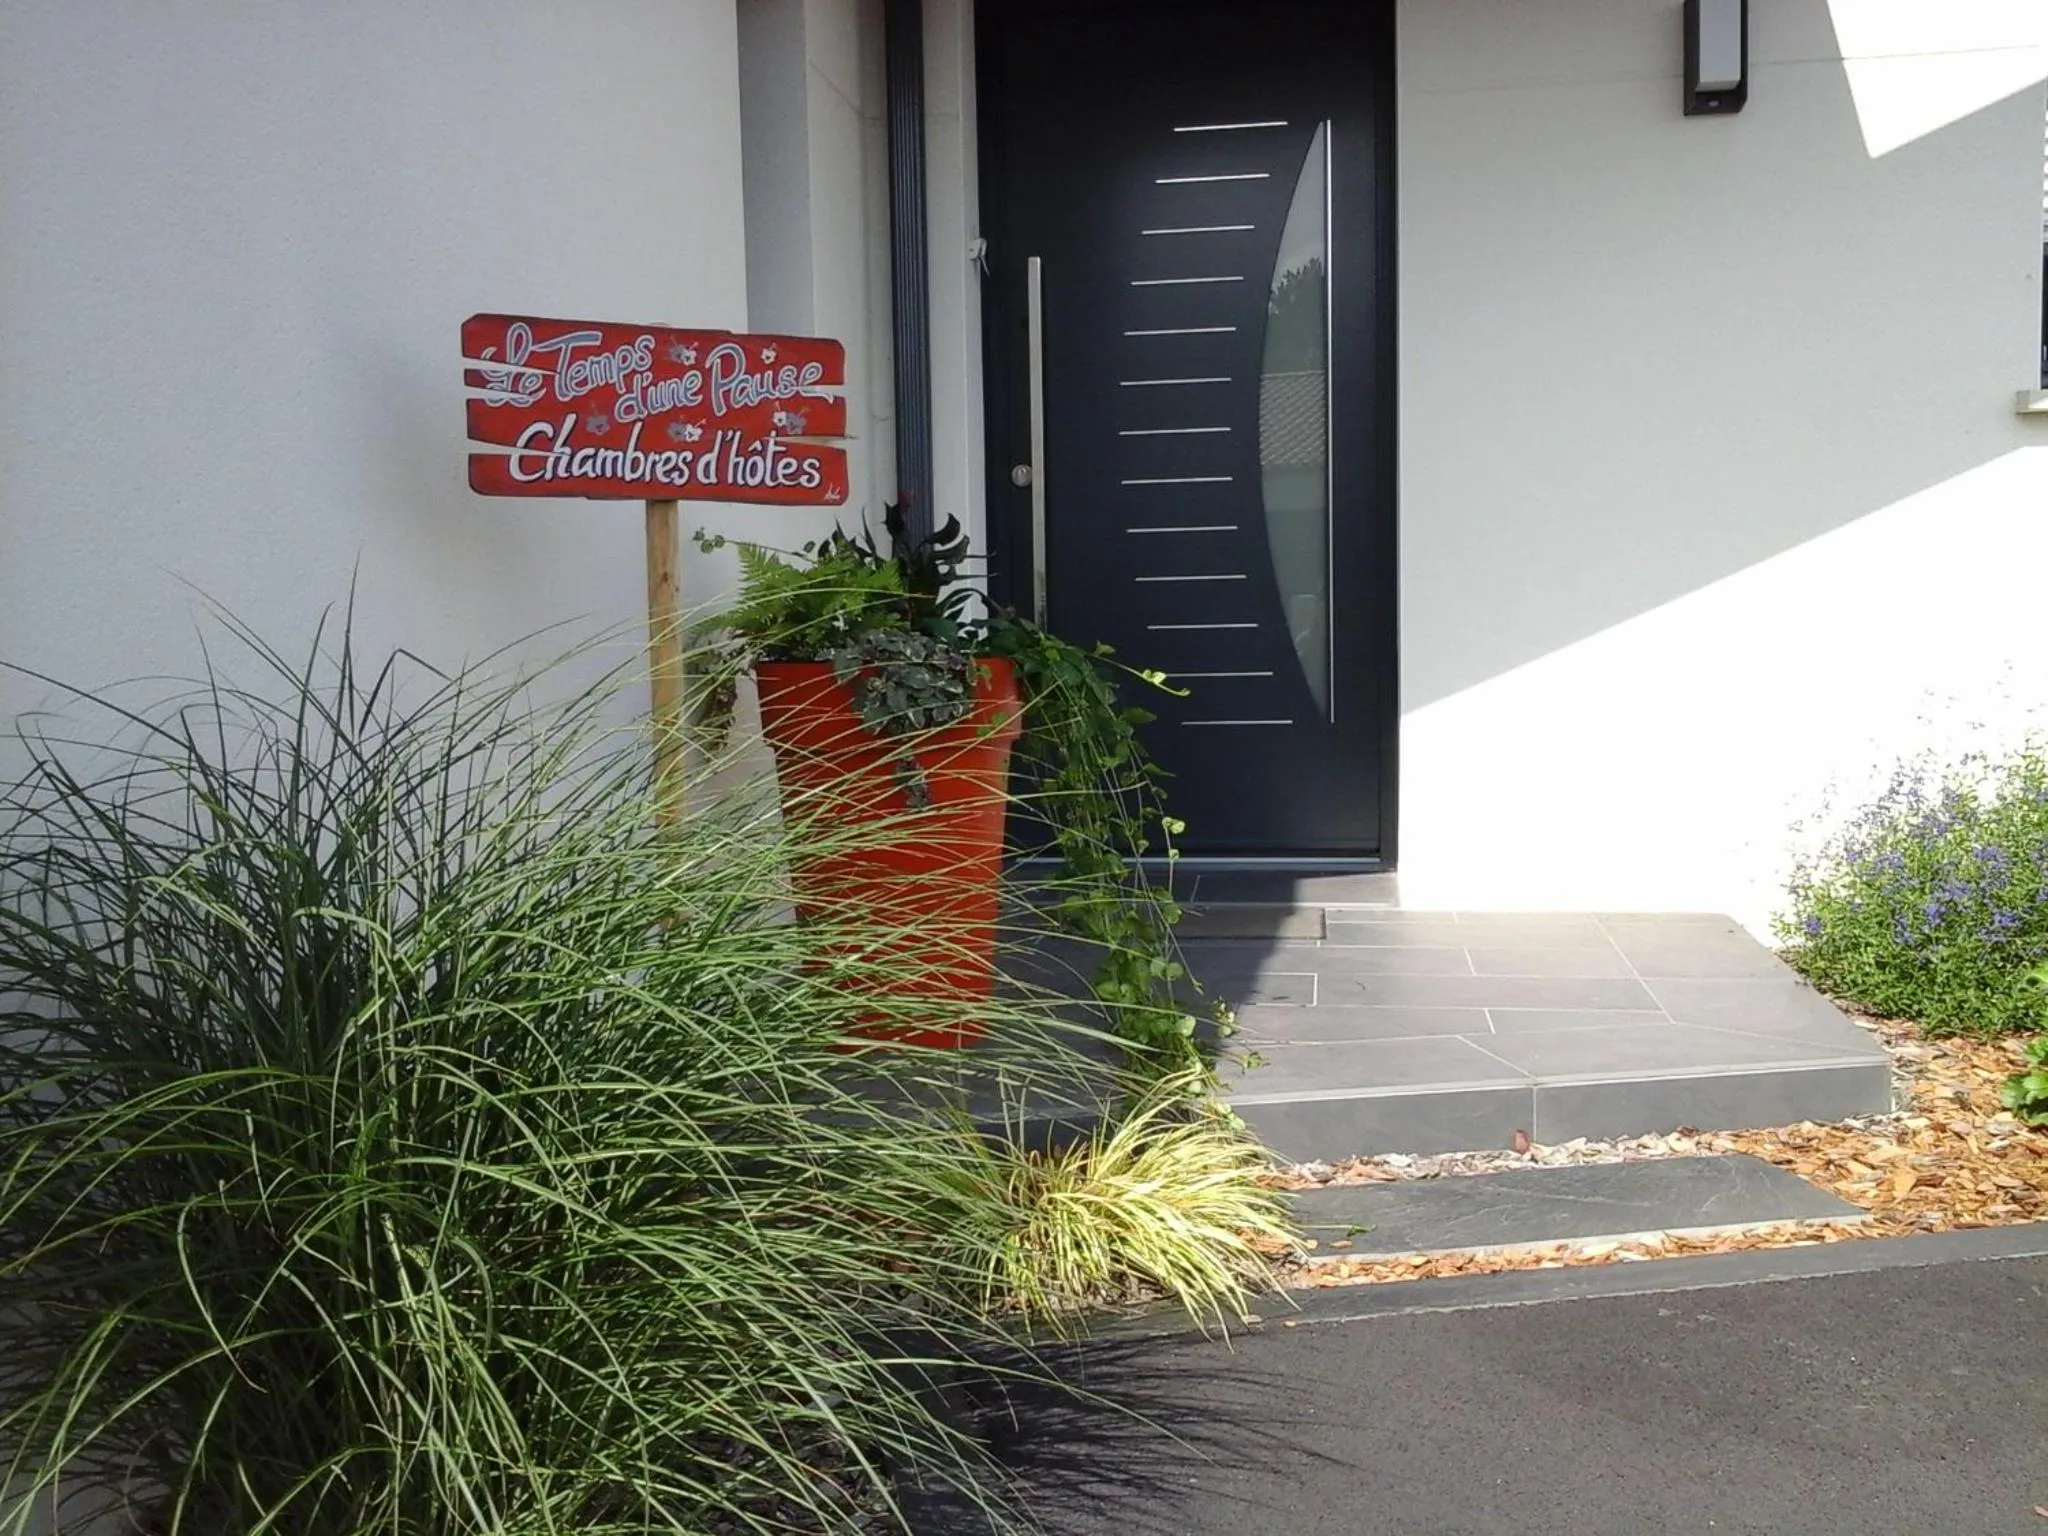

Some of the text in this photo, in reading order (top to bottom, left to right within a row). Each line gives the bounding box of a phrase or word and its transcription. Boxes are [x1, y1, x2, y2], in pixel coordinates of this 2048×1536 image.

[480, 322, 834, 423] Le Temps d'une Pause
[508, 413, 822, 488] Chambres d'hôtes
